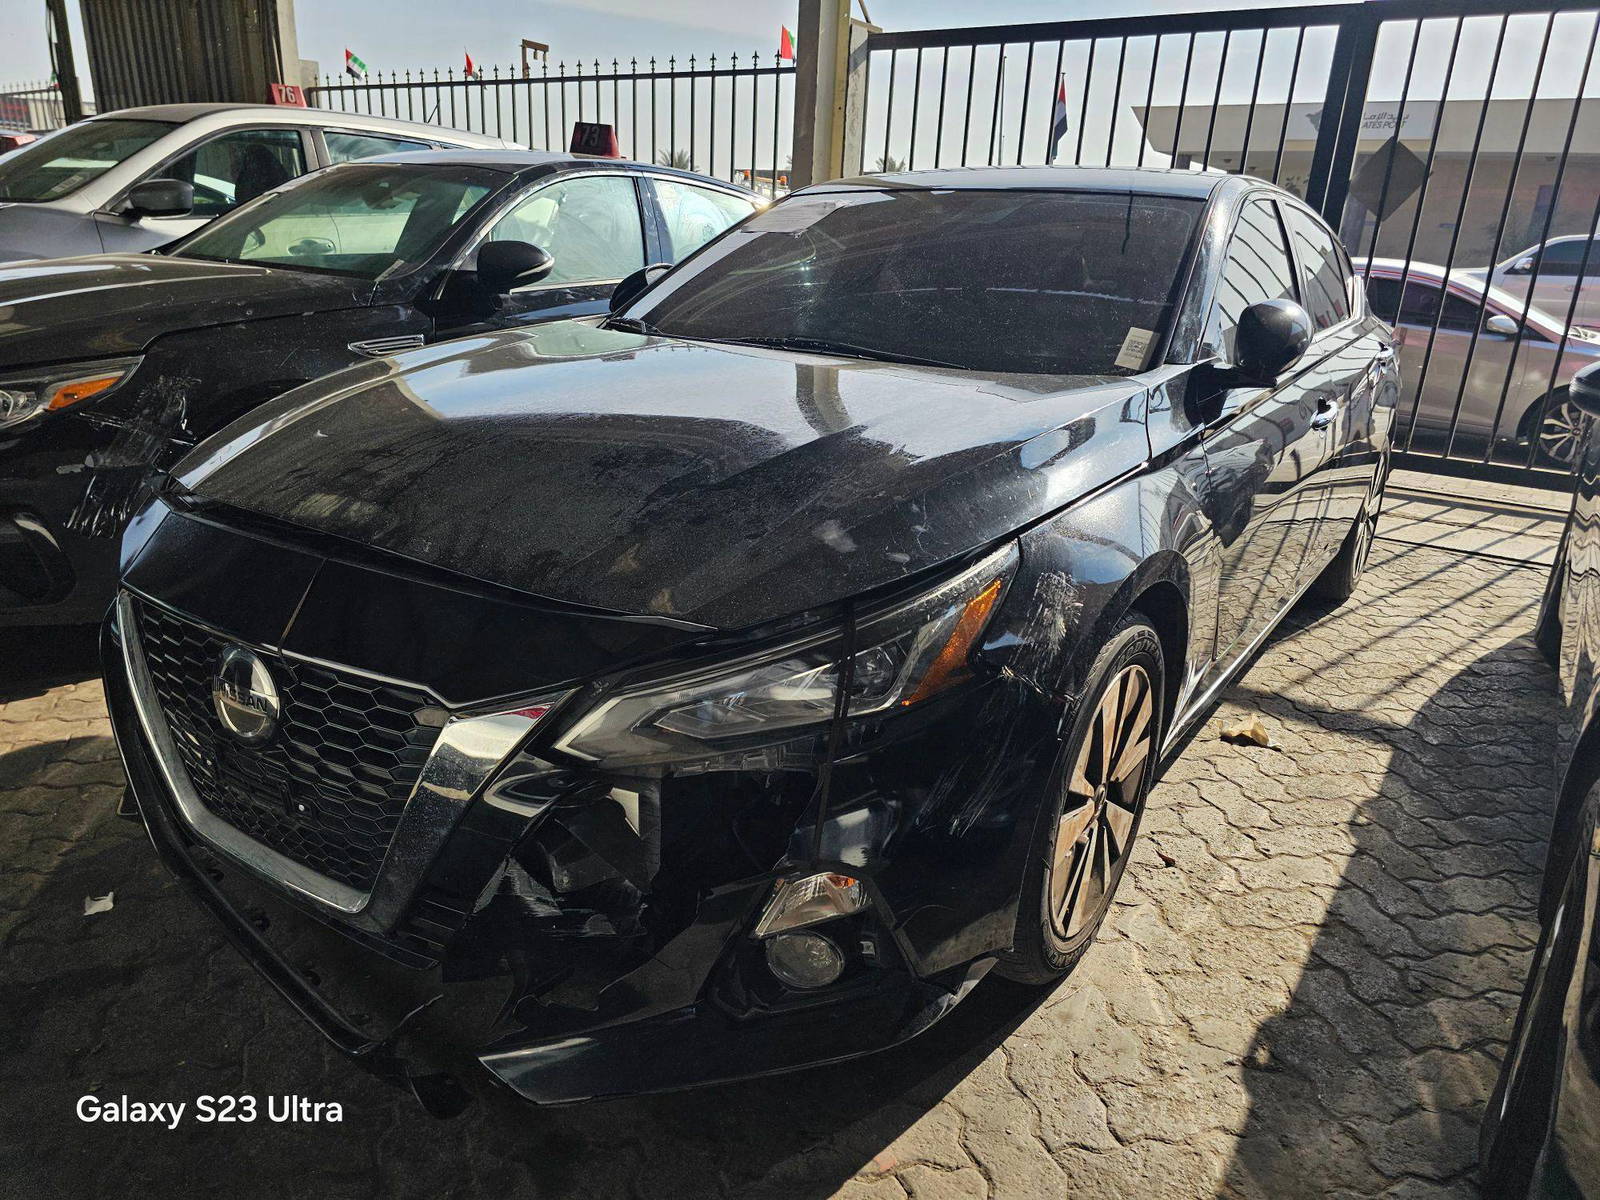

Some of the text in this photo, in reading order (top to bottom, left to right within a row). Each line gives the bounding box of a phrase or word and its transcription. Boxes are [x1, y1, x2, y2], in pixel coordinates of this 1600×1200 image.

[279, 86, 296, 103] 76
[1383, 120, 1407, 129] POT
[581, 125, 600, 146] 73
[219, 680, 268, 713] NISSAN
